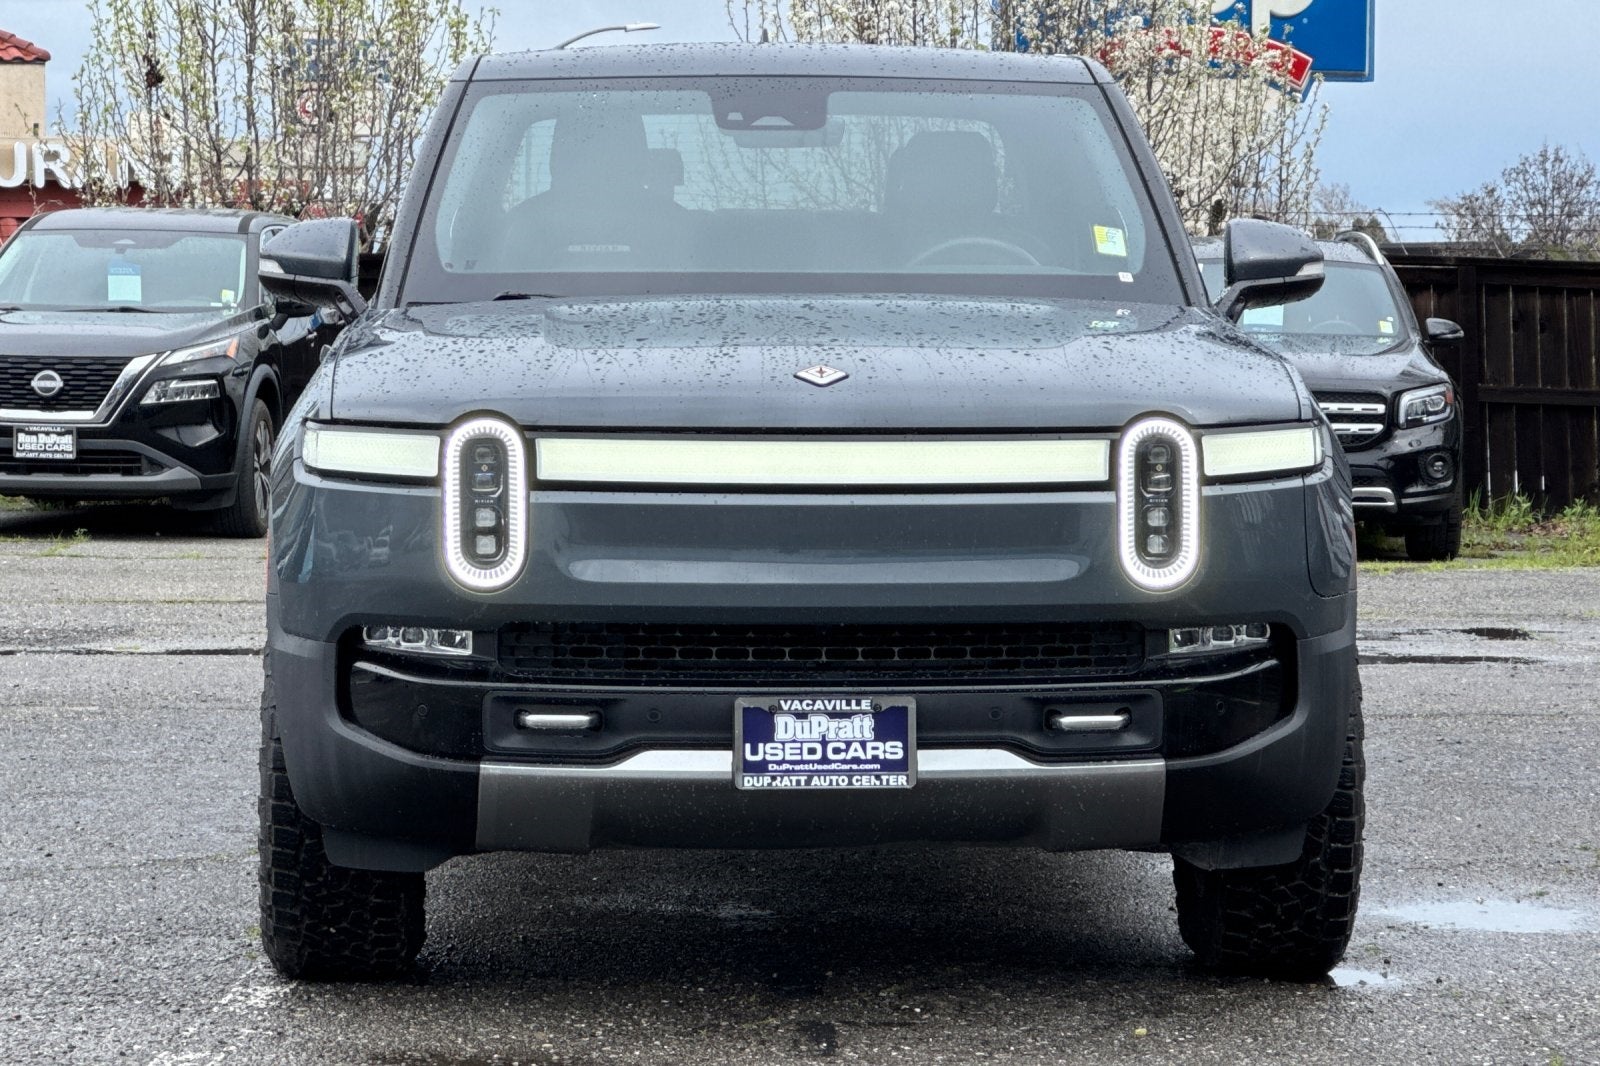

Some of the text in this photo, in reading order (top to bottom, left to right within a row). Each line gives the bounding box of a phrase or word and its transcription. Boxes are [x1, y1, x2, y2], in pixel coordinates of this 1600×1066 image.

[17, 432, 73, 445] Ron DuPratt
[17, 442, 73, 452] USED CARS
[780, 699, 872, 711] VACAVILLE
[774, 714, 875, 741] DuPratt
[745, 741, 903, 761] USED CARS
[768, 763, 881, 771] DuPrattUsedCars.com
[811, 775, 849, 787] AUTO
